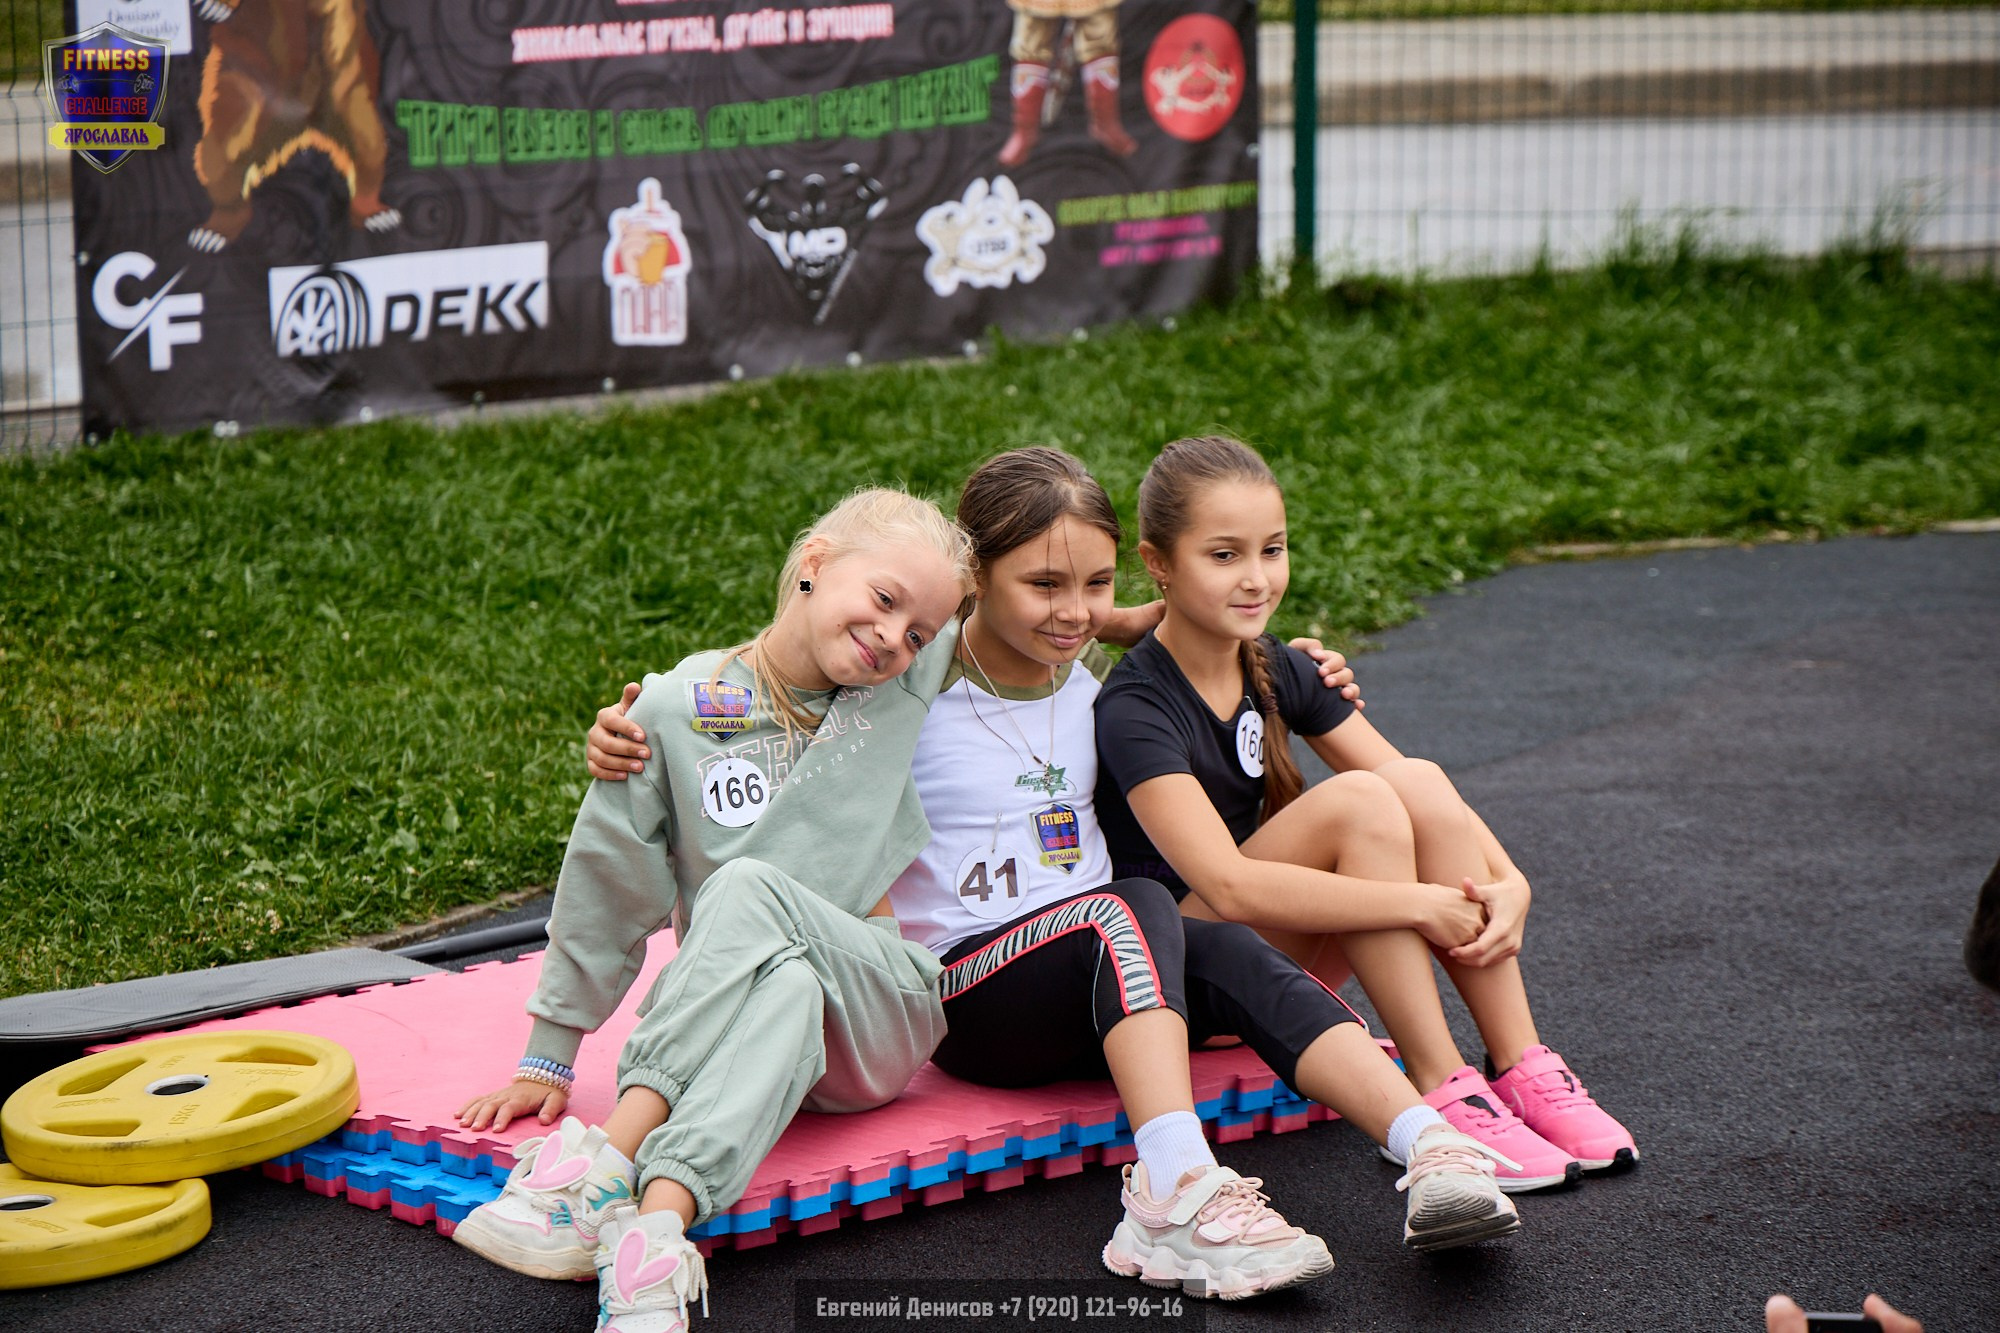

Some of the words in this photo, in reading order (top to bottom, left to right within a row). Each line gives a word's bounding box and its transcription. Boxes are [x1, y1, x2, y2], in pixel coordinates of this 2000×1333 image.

[699, 683, 746, 696] FINESS
[700, 720, 746, 730] ЯРОСЛАВЛЬ
[792, 765, 822, 785] WAY
[829, 753, 844, 767] TO
[849, 738, 866, 754] BE
[709, 773, 764, 813] 166
[1039, 811, 1074, 827] FITNESS
[959, 857, 1019, 902] 41
